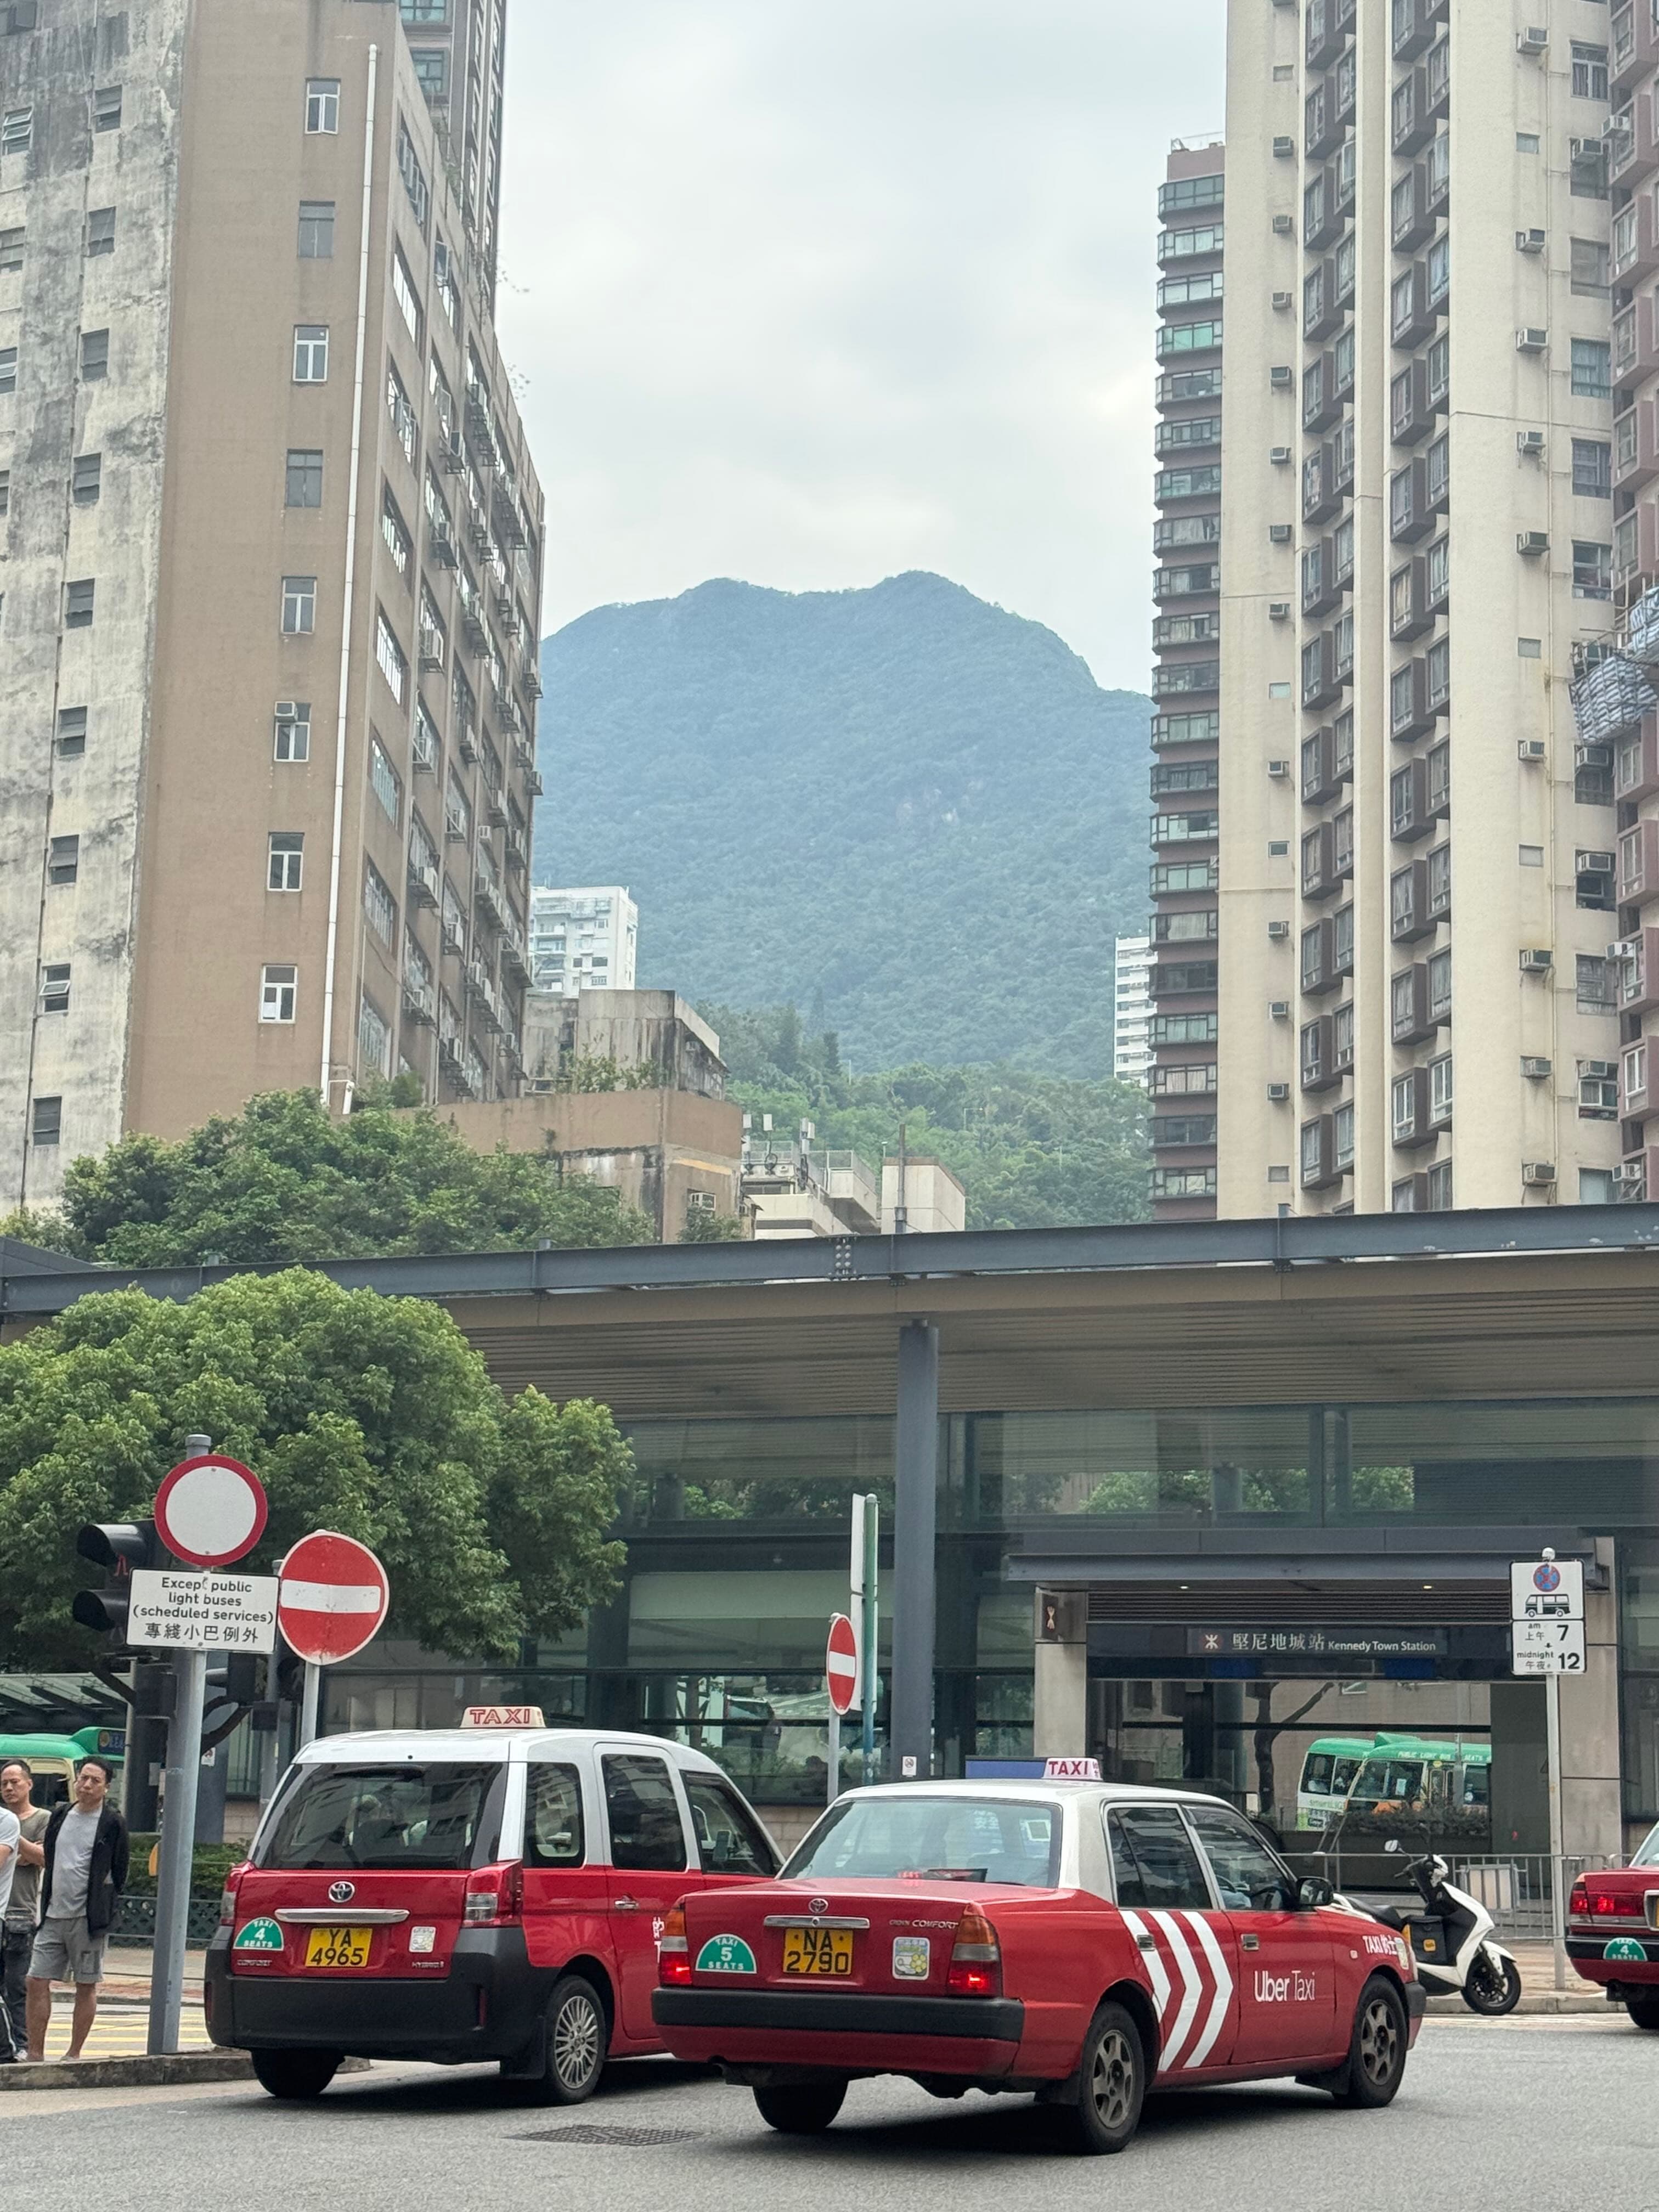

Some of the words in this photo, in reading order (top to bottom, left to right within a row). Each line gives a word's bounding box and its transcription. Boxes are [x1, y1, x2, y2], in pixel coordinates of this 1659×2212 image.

[211, 1582, 252, 1592] public
[168, 1593, 199, 1605] light
[204, 1595, 241, 1606] buses
[133, 1605, 209, 1619] (scheduled
[213, 1610, 274, 1624] services)
[1525, 1632, 1544, 1641] 上午
[1557, 1624, 1569, 1641] 7
[1232, 1633, 1325, 1651] 堅尼地城站
[1328, 1640, 1371, 1653] Kennedy
[1372, 1641, 1398, 1651] Town
[1401, 1640, 1436, 1651] Station
[1516, 1650, 1554, 1659] midnight
[1558, 1652, 1580, 1669] 12
[1525, 1661, 1545, 1669] 午夜
[469, 1708, 531, 1725] TAXI
[1048, 1760, 1088, 1775] TAXI
[253, 1920, 273, 1928] TAXI
[254, 1928, 266, 1940] 4
[330, 1929, 352, 1947] YA
[803, 1930, 833, 1951] NA
[243, 1940, 273, 1948] SEATS
[715, 1937, 738, 1947] TAXI
[720, 1947, 732, 1961] 5
[1620, 1945, 1629, 1954] 4
[311, 1948, 364, 1966] 4965
[786, 1951, 849, 1973] 2790
[708, 1961, 744, 1970] SEATS
[1254, 1971, 1289, 2002] Uber
[1291, 1970, 1315, 2001] Taxi
